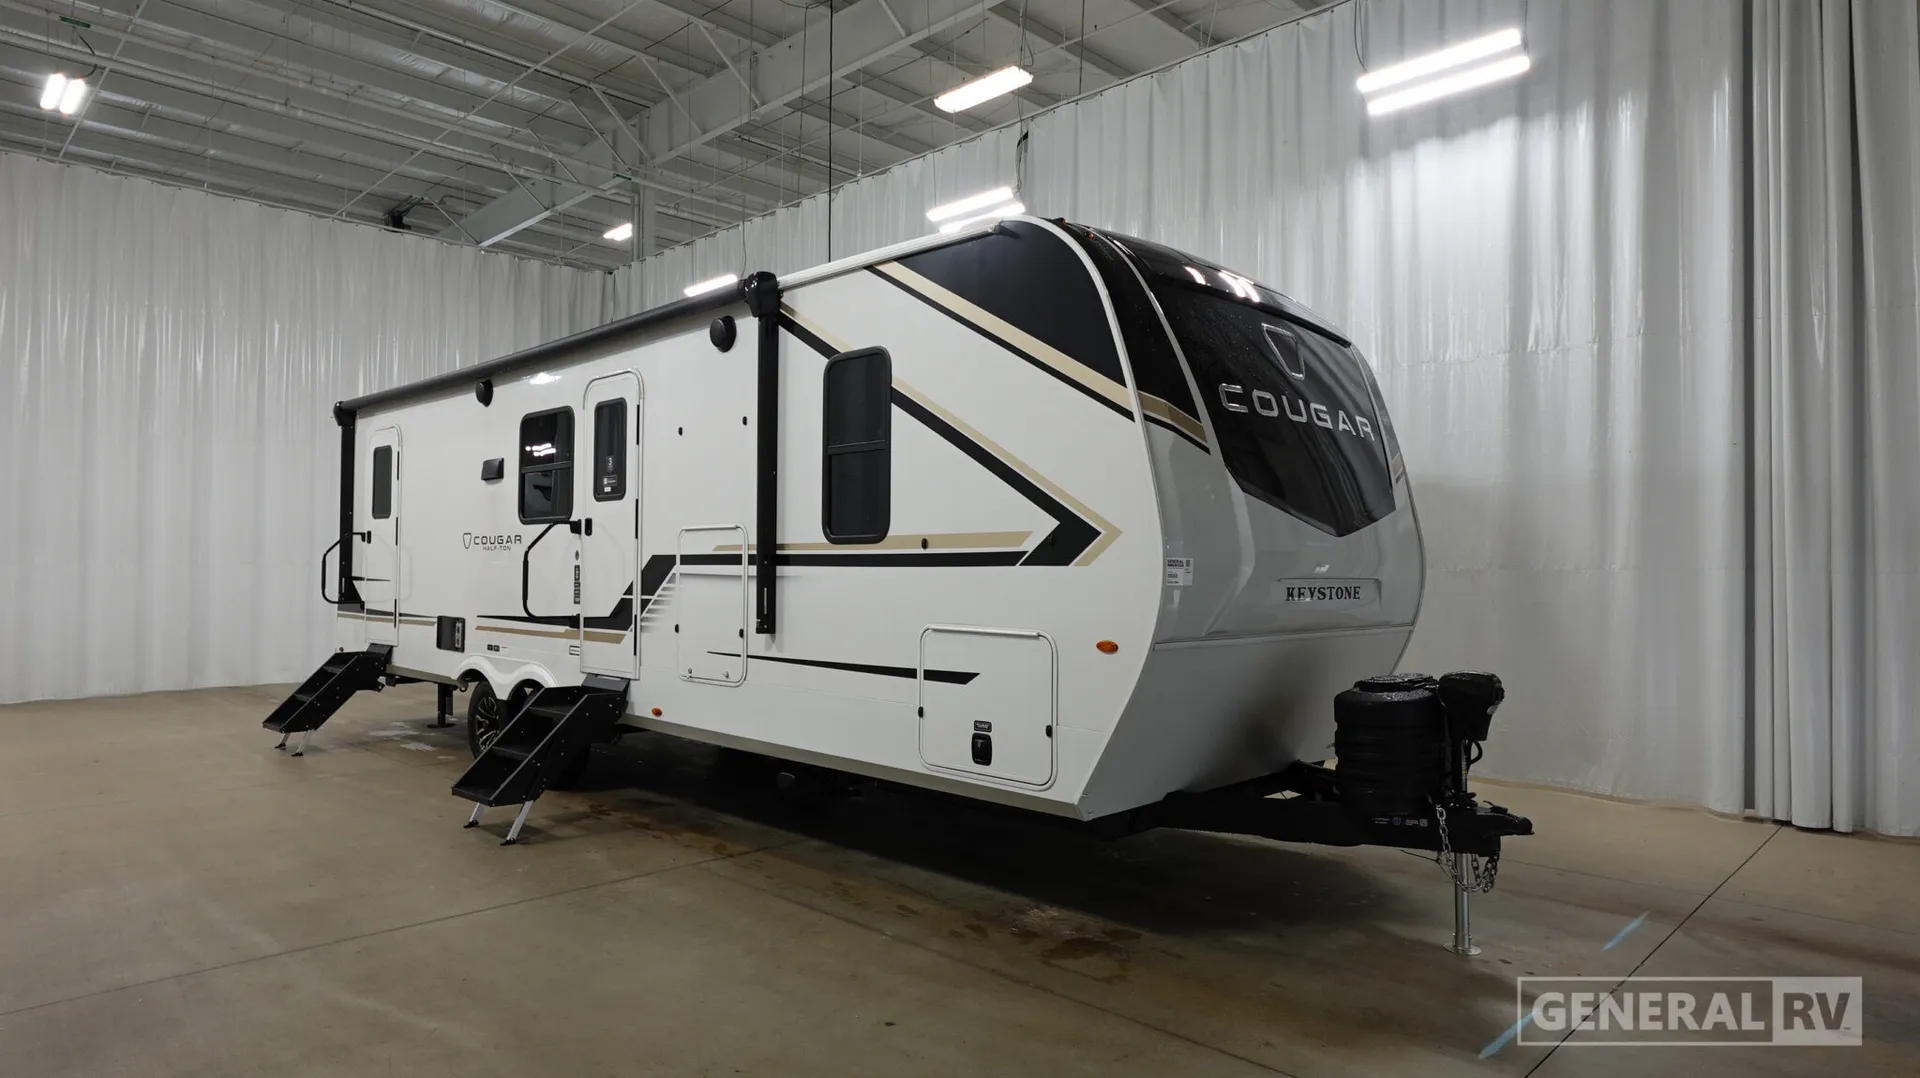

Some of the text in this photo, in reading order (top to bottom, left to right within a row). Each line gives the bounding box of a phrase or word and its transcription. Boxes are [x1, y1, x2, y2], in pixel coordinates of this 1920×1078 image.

[1218, 383, 1375, 441] COUGAR
[473, 535, 522, 546] COUGAR
[1285, 586, 1361, 601] KEYSTONE
